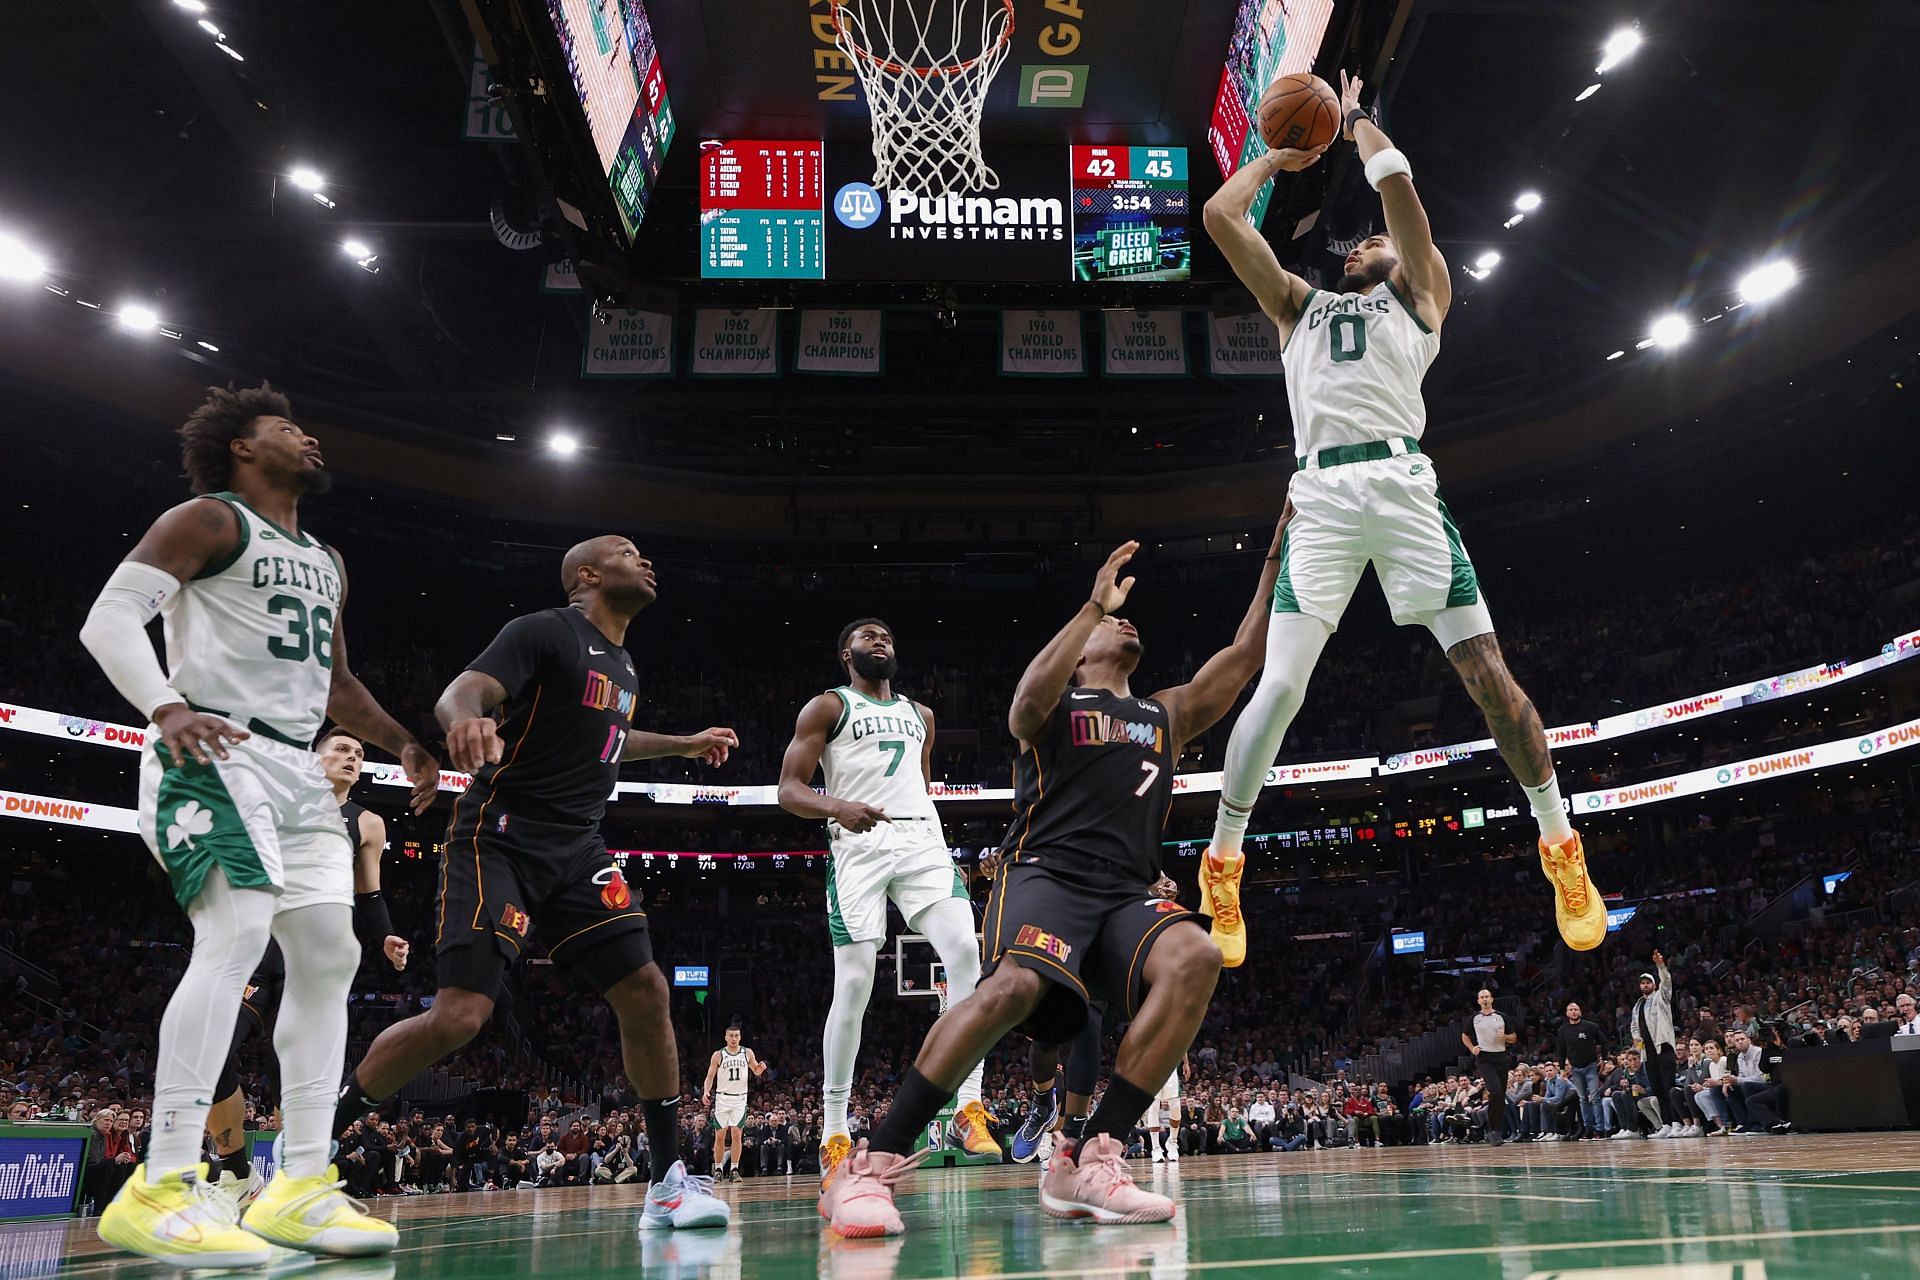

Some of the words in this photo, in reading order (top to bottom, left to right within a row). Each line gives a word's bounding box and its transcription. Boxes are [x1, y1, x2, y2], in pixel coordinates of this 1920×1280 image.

[1086, 159, 1116, 176] 42
[1145, 160, 1173, 178] 45
[890, 190, 1062, 225] Putnam
[1113, 195, 1152, 210] 3:54
[890, 226, 1063, 240] INVESTMENTS
[1112, 232, 1149, 249] BLEED
[1109, 247, 1152, 266] GREEN
[618, 320, 645, 331] 1963
[724, 319, 749, 331] 1962
[829, 317, 852, 329] 1961
[1028, 320, 1054, 332] 1960
[1131, 321, 1157, 332] 1959
[1236, 323, 1259, 334] 1957
[609, 334, 653, 345] WORLD
[714, 333, 758, 345] WORLD
[819, 331, 862, 344] WORLD
[1021, 334, 1063, 346] WORLD
[1124, 335, 1167, 347] WORLD
[1227, 336, 1268, 348] WORLD
[1329, 314, 1366, 362] 0
[593, 347, 666, 360] CHAMPIONS
[700, 347, 770, 361] CHAMPIONS
[805, 345, 874, 359] CHAMPIONS
[1008, 348, 1077, 360] CHAMPIONS
[1111, 349, 1180, 361] CHAMPIONS
[1216, 349, 1281, 361] CHAMPIONS
[267, 594, 333, 670] 36
[582, 669, 637, 721] MIAMI
[852, 716, 922, 743] CELTICS
[1070, 710, 1164, 755] MIAMI
[879, 741, 905, 777] 7
[1748, 752, 1814, 776] DUNKIN'
[1135, 760, 1159, 797] 7
[1618, 781, 1677, 803] DUNKIN'
[5, 797, 89, 820] DUNKIN'
[1486, 806, 1519, 819] Bank
[1419, 819, 1436, 828] 3:54
[1357, 828, 1375, 840] 19
[404, 849, 414, 858] 45
[1179, 848, 1196, 856] 8/20
[698, 862, 716, 870] 7/15
[733, 862, 755, 870] 17/33
[722, 1060, 746, 1069] CELTICS
[728, 1068, 740, 1081] 11
